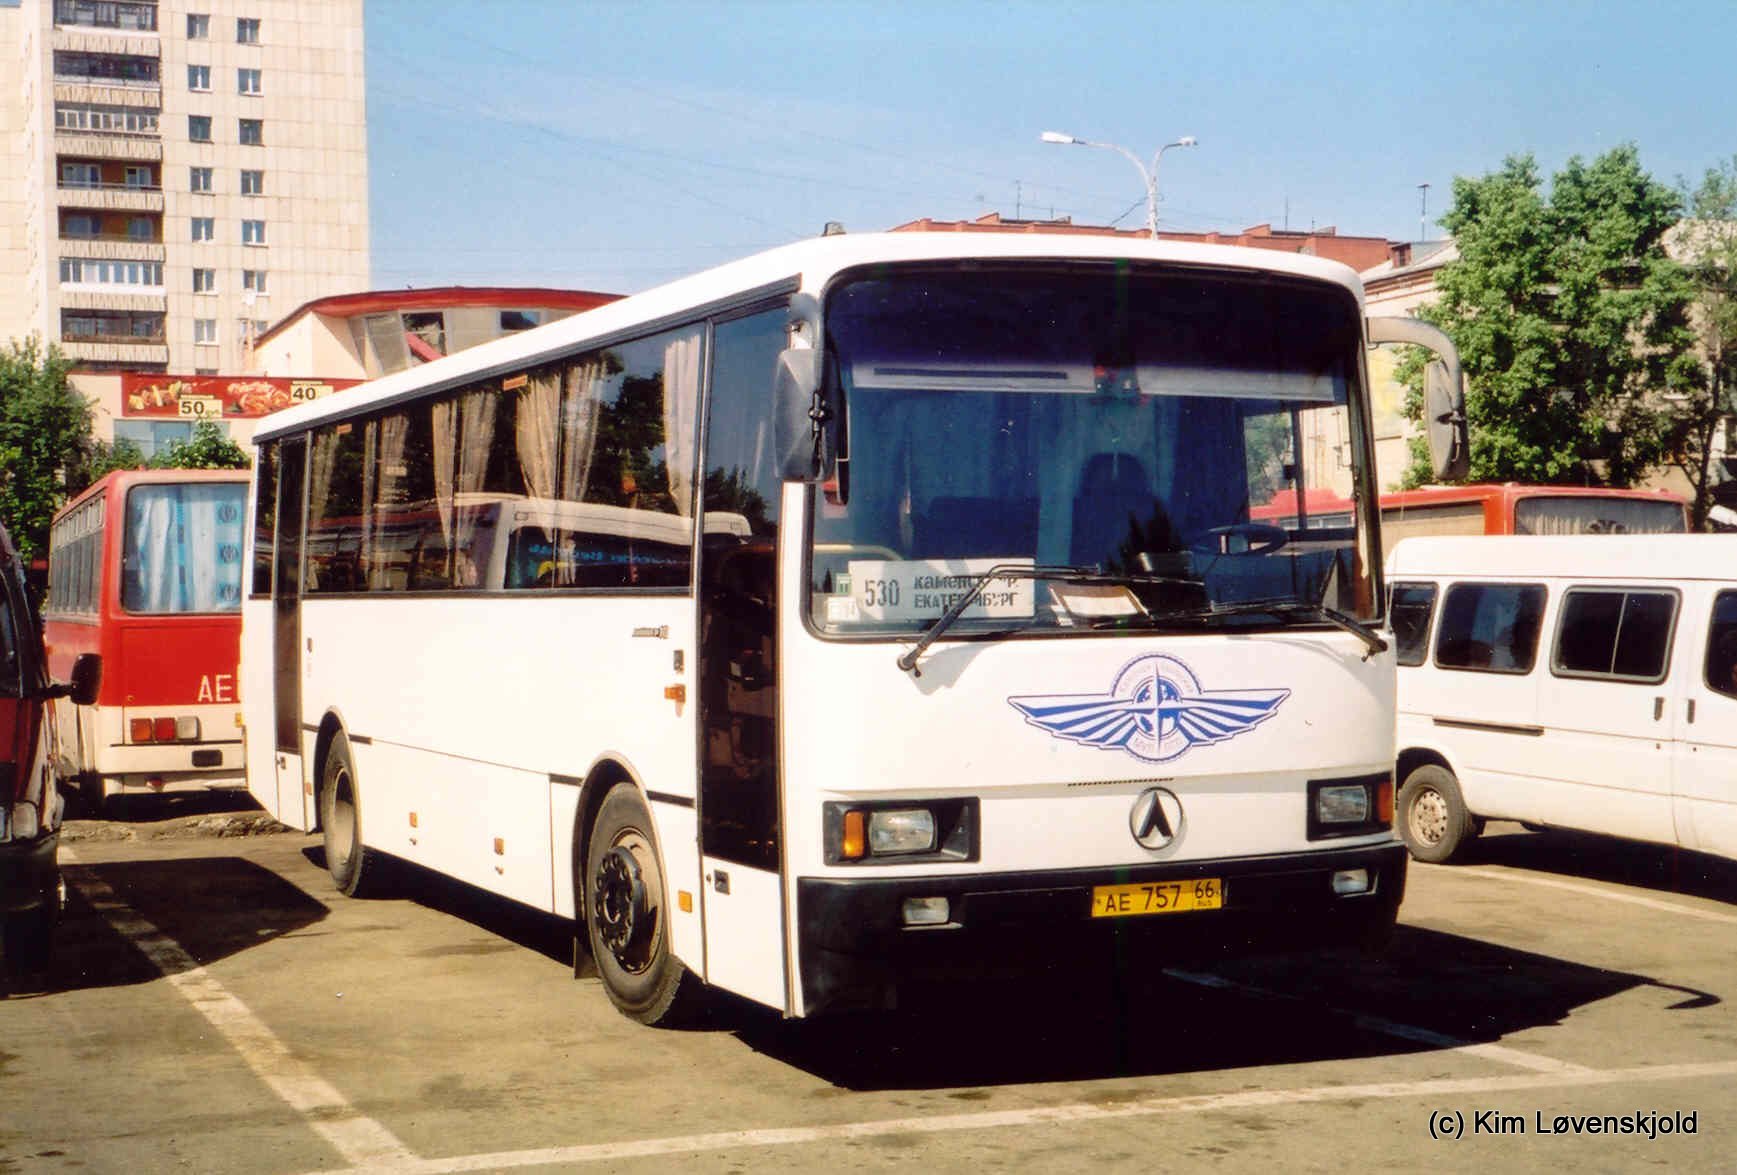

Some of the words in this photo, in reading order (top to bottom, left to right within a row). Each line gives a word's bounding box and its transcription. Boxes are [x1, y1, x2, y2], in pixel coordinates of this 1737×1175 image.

[293, 387, 316, 400] 40
[181, 400, 205, 415] 50
[865, 578, 899, 606] 530
[914, 592, 1018, 608] ЕКАТЕНБУРГ
[1141, 884, 1181, 910] 757
[1195, 880, 1214, 899] 66
